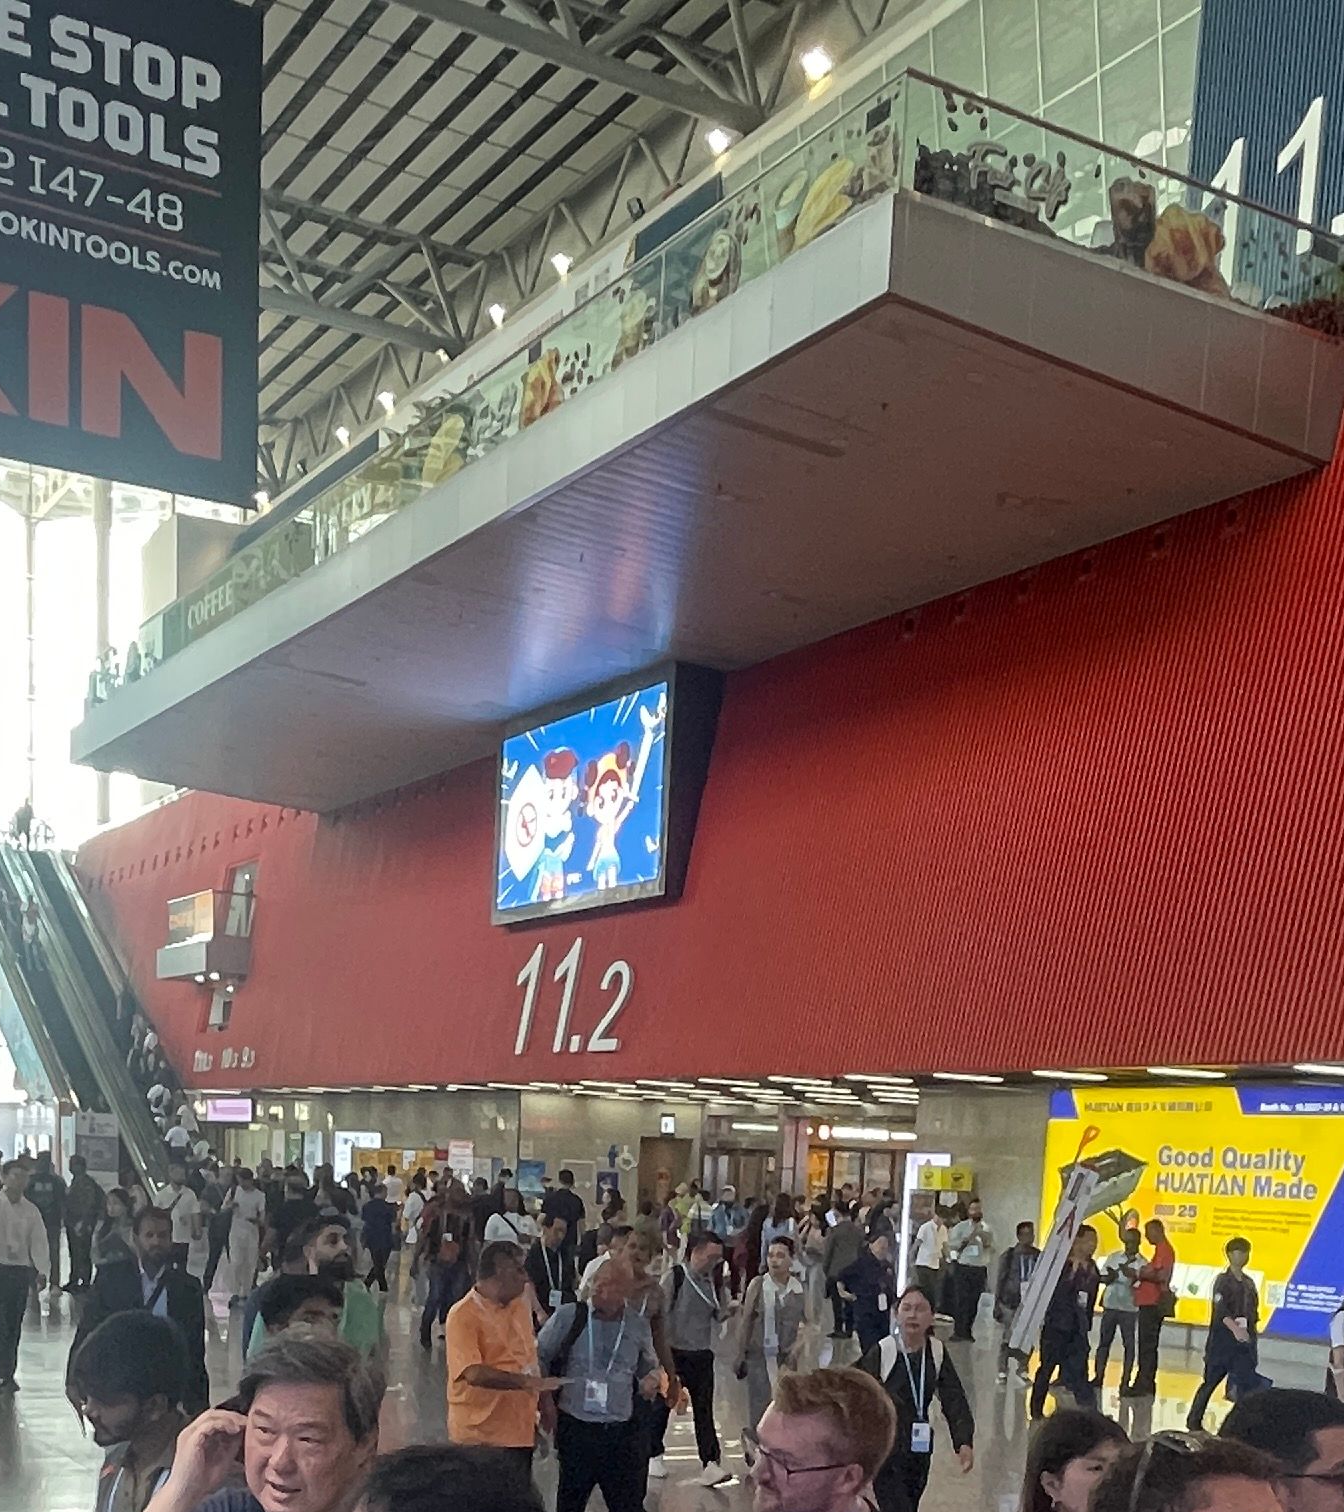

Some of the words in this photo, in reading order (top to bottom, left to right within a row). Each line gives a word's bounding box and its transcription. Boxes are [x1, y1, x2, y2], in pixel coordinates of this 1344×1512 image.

[49, 14, 222, 109] STOP
[20, 72, 221, 178] TOOLS
[28, 154, 184, 232] I47-48
[513, 936, 633, 1056] 11.2
[1155, 1171, 1247, 1197] HUATIAN
[1252, 1175, 1319, 1201] Made
[1157, 1145, 1214, 1168] Good
[1221, 1146, 1307, 1178] Quality
[1177, 1204, 1198, 1218] 25
